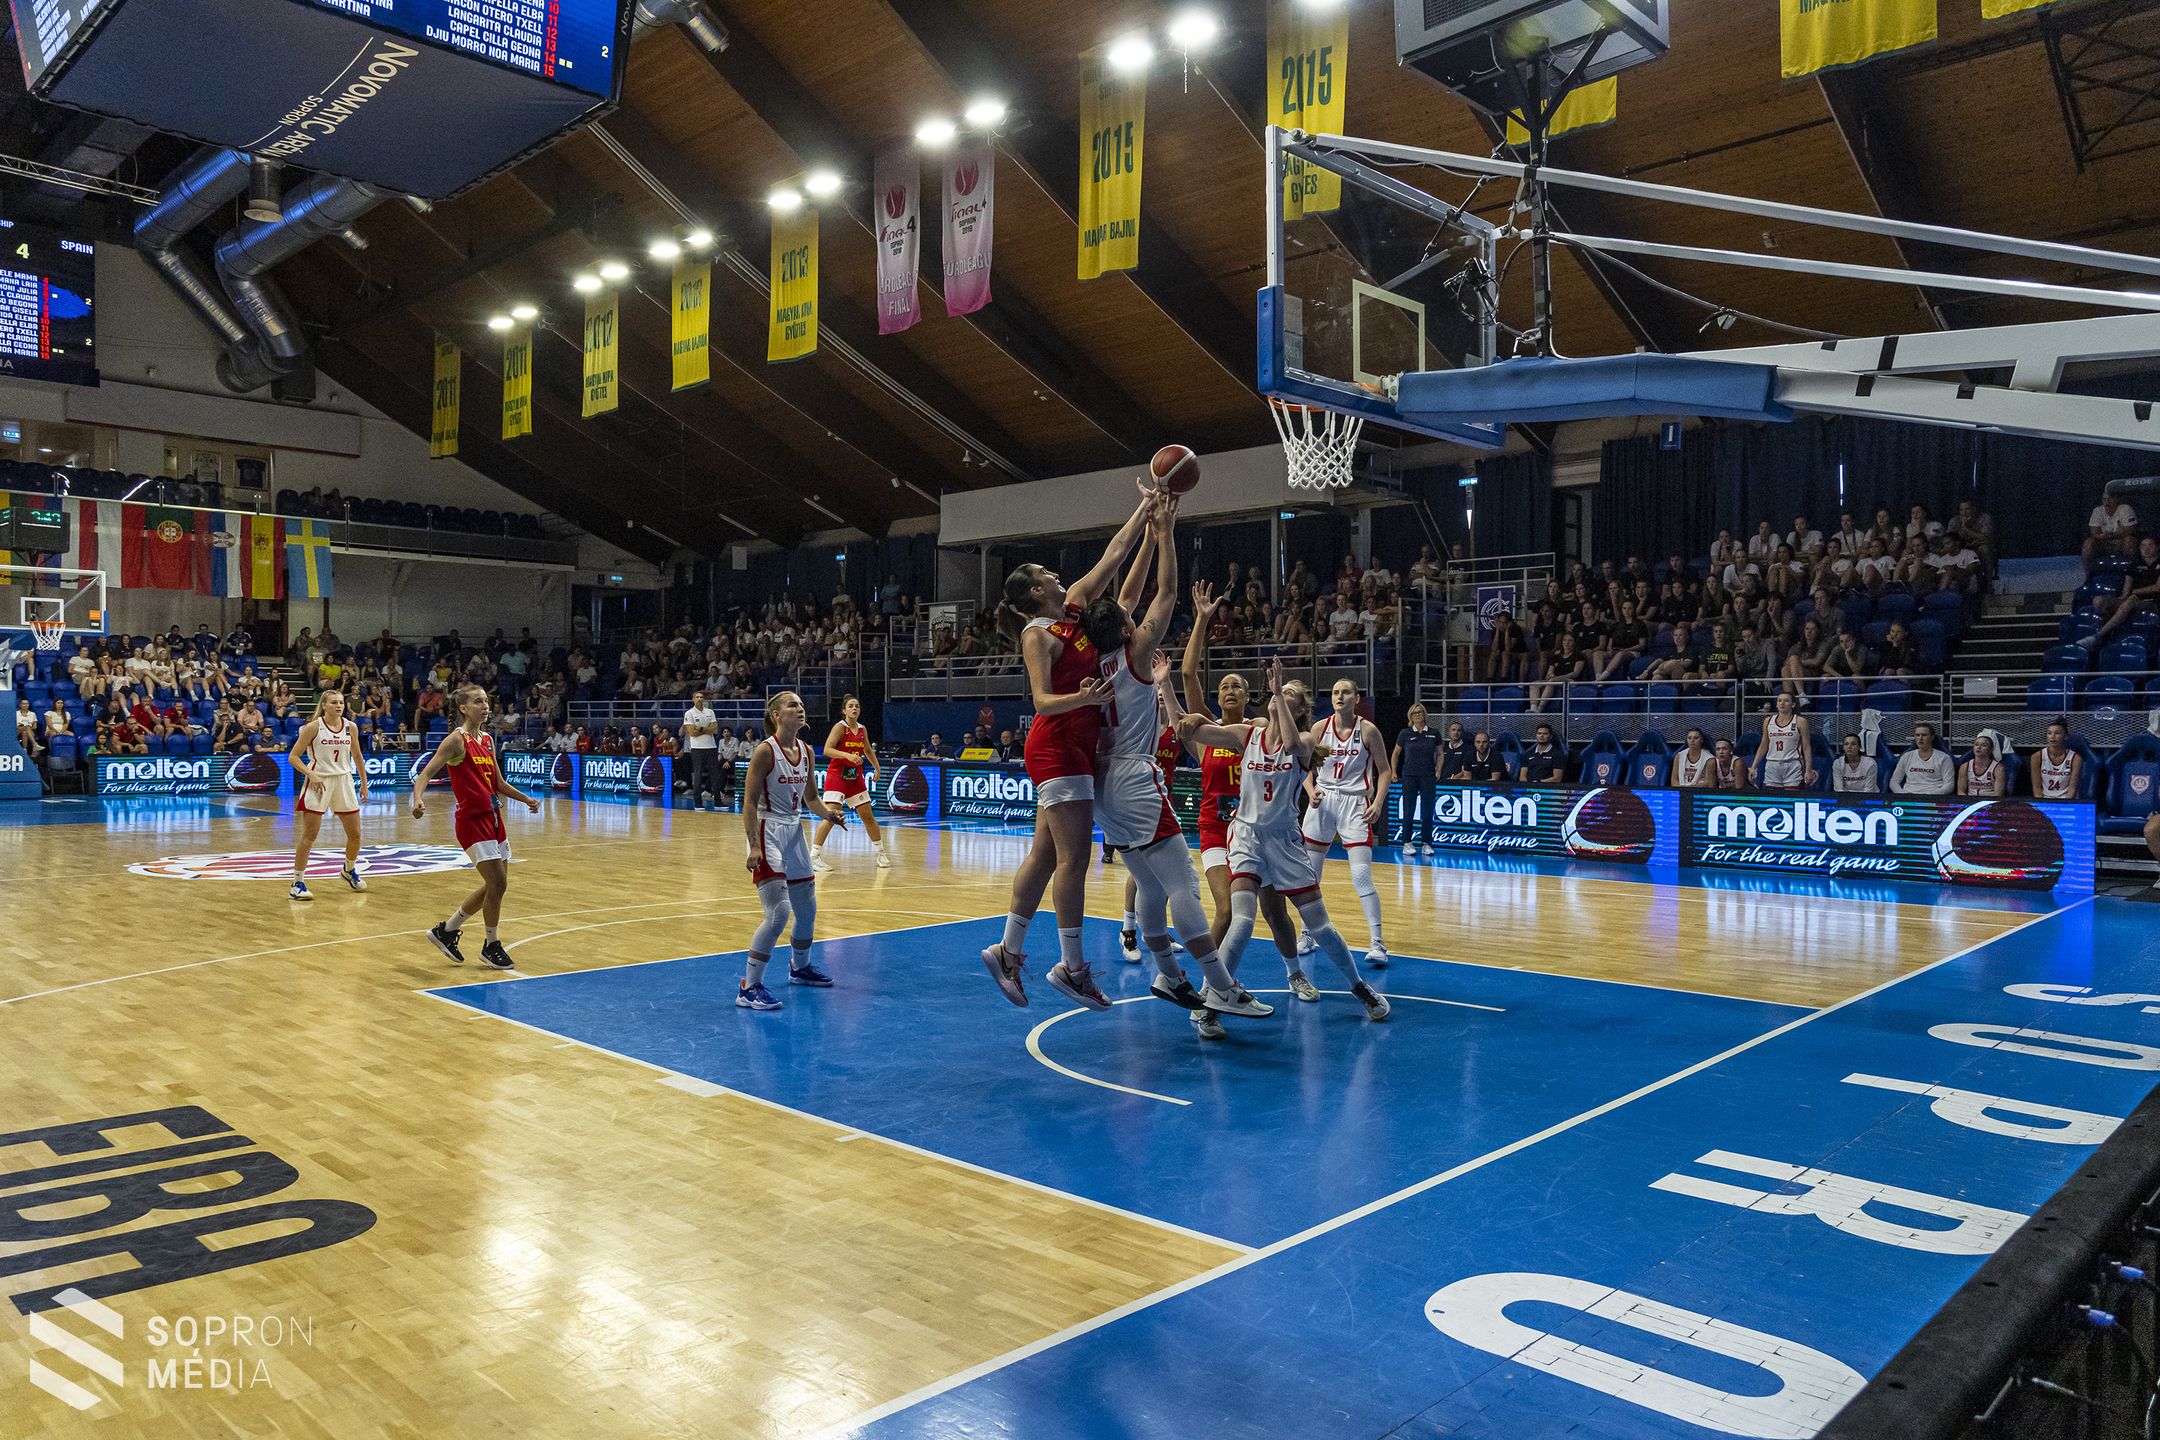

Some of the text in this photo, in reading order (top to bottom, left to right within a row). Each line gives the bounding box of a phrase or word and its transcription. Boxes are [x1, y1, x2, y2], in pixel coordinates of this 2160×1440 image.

[521, 5, 544, 22] ELBA
[548, 14, 558, 27] 11
[548, 2, 560, 15] 10
[448, 5, 557, 52] LANGARITA CLAUDIA 13
[482, 5, 514, 24] OTERO
[515, 15, 543, 35] TXELL
[546, 27, 558, 40] 12
[426, 24, 555, 77] DJIU MORRO NOA MARIA 15
[449, 20, 556, 64] CAPEL CILLA GEDNA 14
[601, 45, 609, 58] 2
[301, 41, 420, 135] NOVOMATIC
[278, 95, 323, 126] SOPRON
[1092, 120, 1134, 184] 2015
[907, 215, 917, 233] 4
[16, 243, 30, 259] 4
[61, 240, 94, 254] SPAIN
[7, 291, 38, 302] CLAUDIA
[17, 286, 38, 296] JULIA
[15, 314, 38, 324] ELENA
[7, 334, 38, 344] CLAUDIA
[16, 327, 38, 337] TXELL
[85, 338, 92, 346] 2
[14, 347, 38, 358] MARIA
[506, 343, 528, 382] 2011
[1329, 749, 1359, 757] ESKO
[1775, 741, 1784, 751] 13
[333, 750, 340, 763] 7
[507, 755, 545, 774] molten
[106, 758, 210, 780] molten
[585, 758, 630, 778] molten
[1246, 761, 1293, 773] ČESKO
[1333, 763, 1345, 779] 17
[103, 781, 211, 795] For the real game
[952, 773, 1033, 801] molten
[1263, 781, 1273, 802] 3
[2048, 780, 2061, 791] 24
[949, 801, 1034, 820] For the real game
[1708, 802, 1898, 846] molten
[1432, 827, 1449, 842] he
[1451, 829, 1488, 845] real
[1487, 837, 1539, 852] game
[1701, 844, 1900, 875] For the real game
[0, 1105, 378, 1317] FIBA
